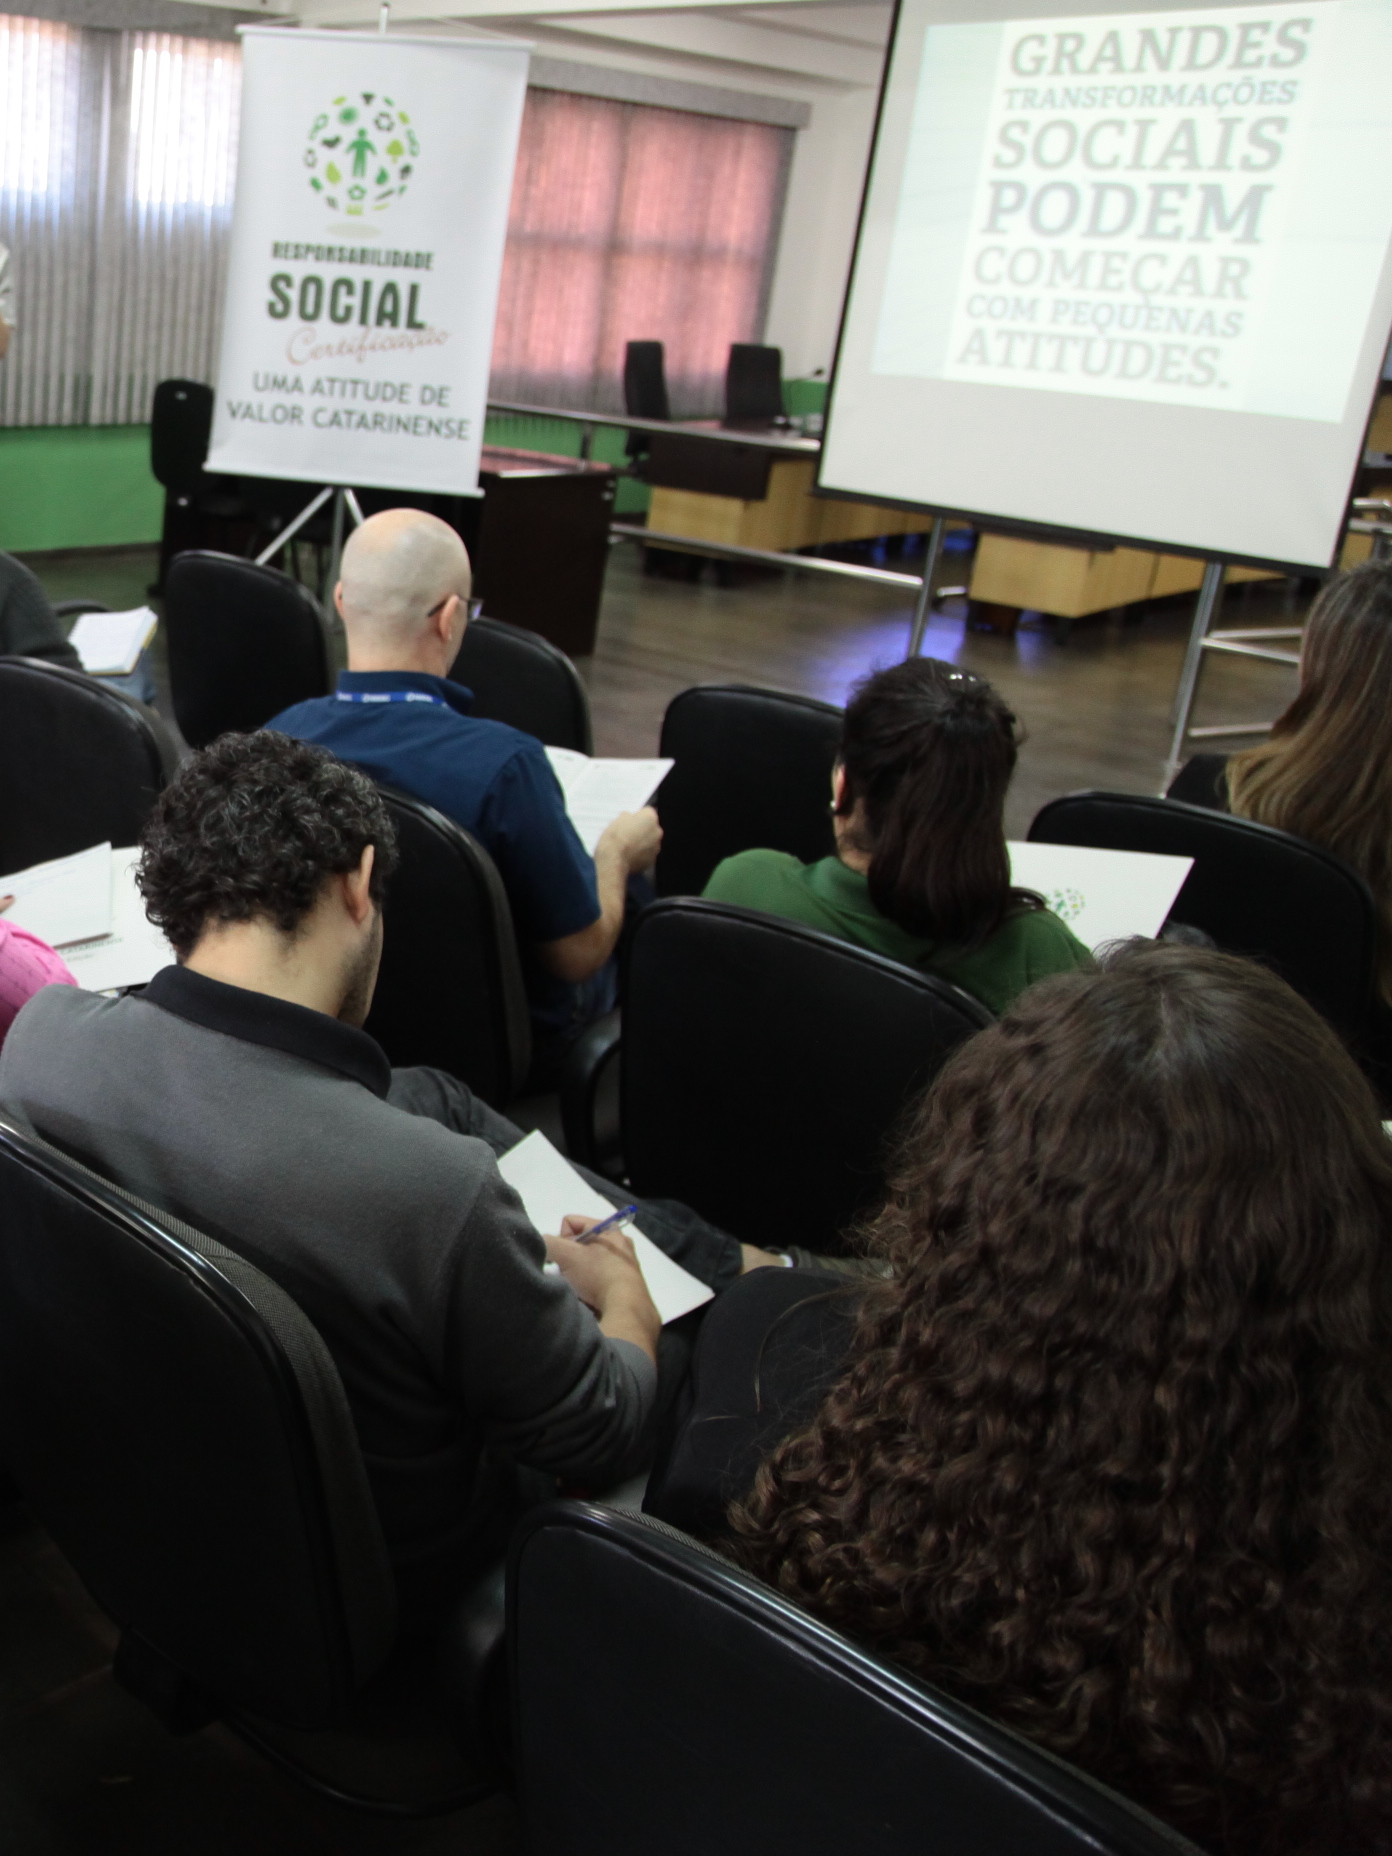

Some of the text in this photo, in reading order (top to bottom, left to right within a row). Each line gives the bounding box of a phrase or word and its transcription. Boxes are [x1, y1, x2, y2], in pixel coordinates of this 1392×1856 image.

[1010, 17, 1314, 77] GRANDES
[1003, 76, 1299, 113] TRANSFORMAÇÕES
[992, 115, 1290, 173] SOCIAIS
[981, 180, 1275, 245] PODEM
[272, 241, 434, 271] RESPONSABILIDADE
[974, 245, 1252, 307] COMEÇAR
[268, 272, 426, 330] SOCIAL
[966, 294, 1244, 339] COM PEQUENAS
[958, 326, 1230, 389] ATITUDES.
[253, 371, 451, 407] UMA ATITUDE DE
[227, 400, 472, 440] VALOR CATARINENSE
